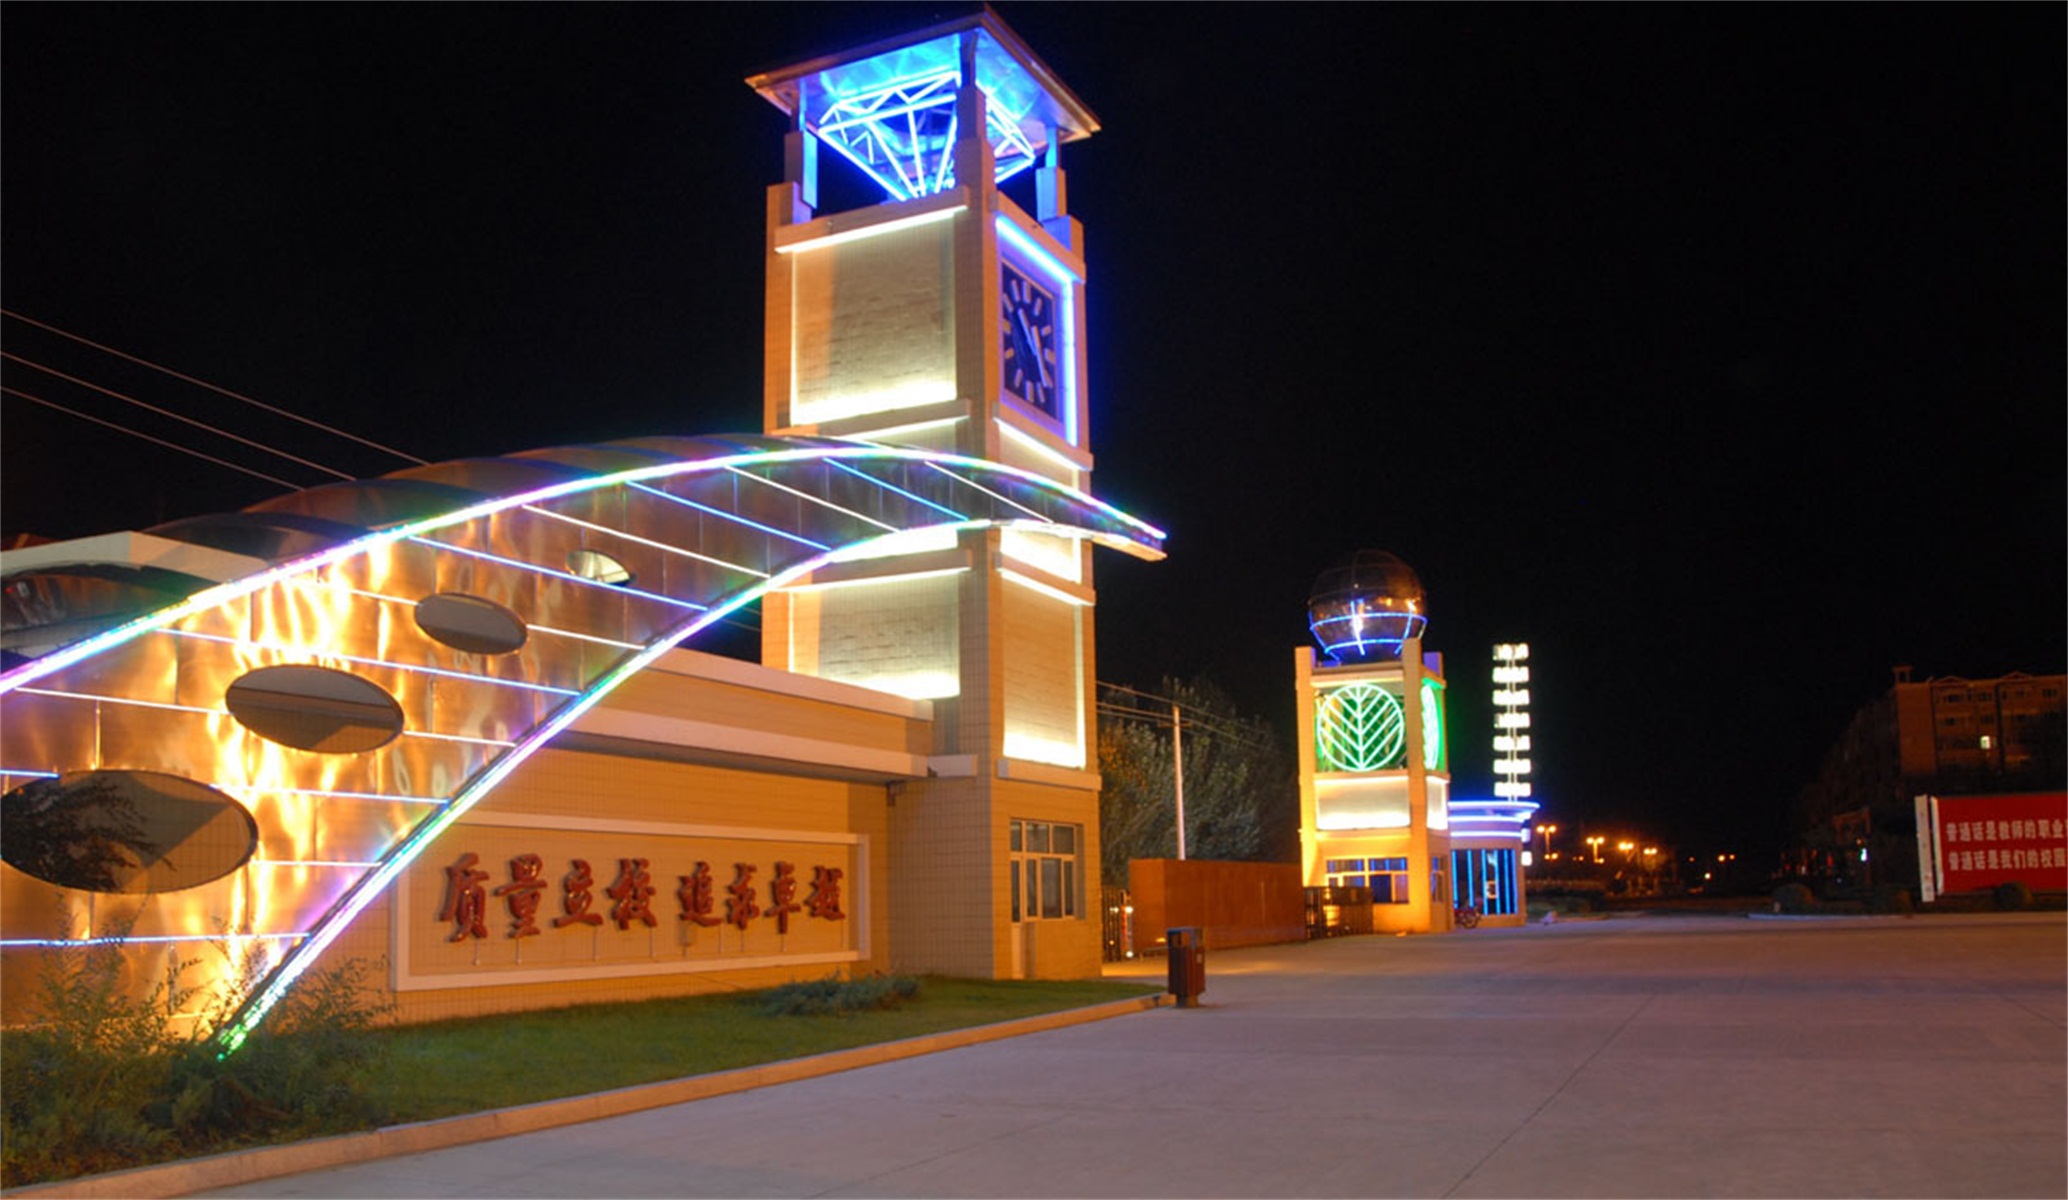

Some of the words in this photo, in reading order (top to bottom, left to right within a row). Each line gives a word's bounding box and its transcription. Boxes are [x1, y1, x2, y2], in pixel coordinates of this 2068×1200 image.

[1946, 819, 2067, 842] 普通话是教师的职业
[440, 853, 658, 942] 质量立校
[678, 861, 846, 934] 追求卓越
